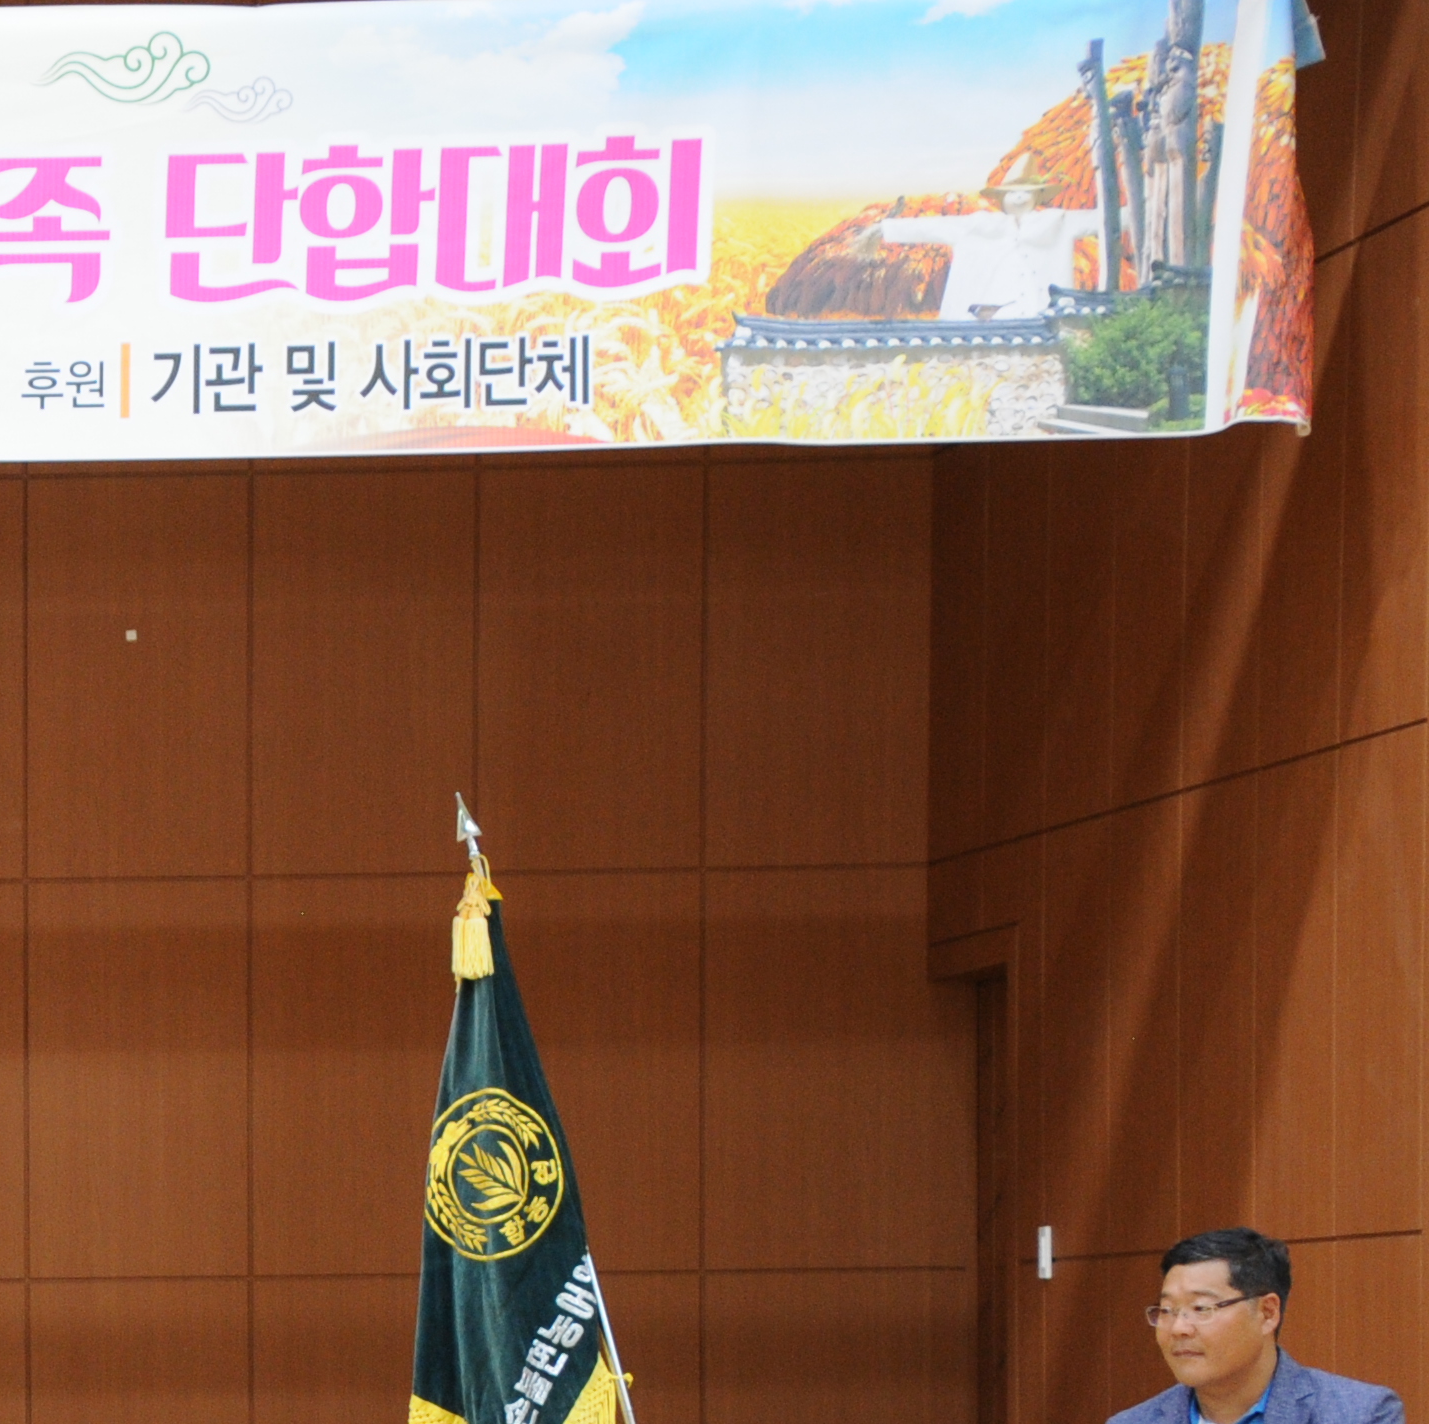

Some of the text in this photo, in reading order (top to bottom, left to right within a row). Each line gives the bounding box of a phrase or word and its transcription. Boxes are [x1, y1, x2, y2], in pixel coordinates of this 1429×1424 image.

[164, 135, 704, 304] 단합대회
[20, 333, 593, 414] 후원 기관 및 사회단체
